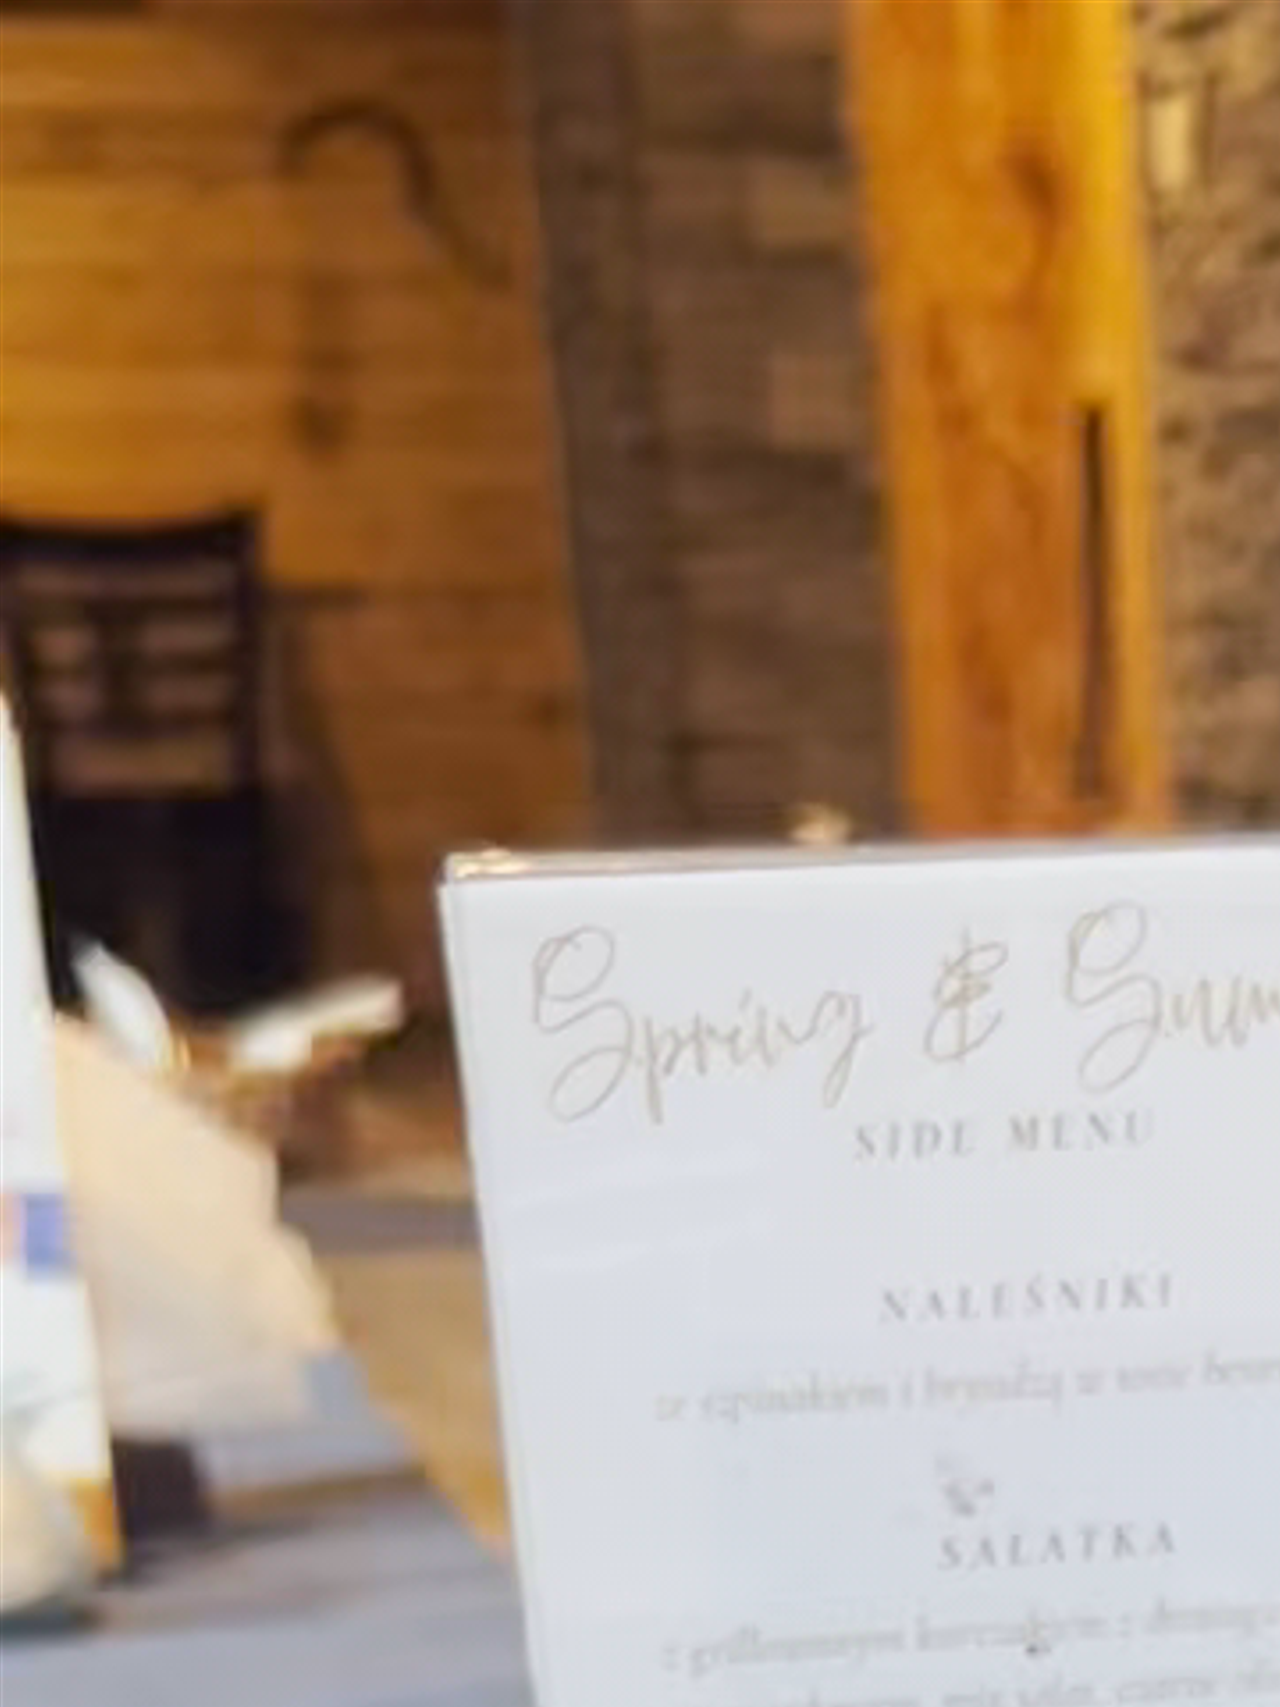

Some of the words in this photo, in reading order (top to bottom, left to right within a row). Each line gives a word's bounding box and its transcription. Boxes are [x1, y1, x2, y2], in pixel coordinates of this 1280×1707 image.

[531, 924, 875, 1125] Spring
[922, 925, 1009, 1062] &
[852, 1116, 977, 1161] SIDE
[1006, 1108, 1155, 1153] MENU
